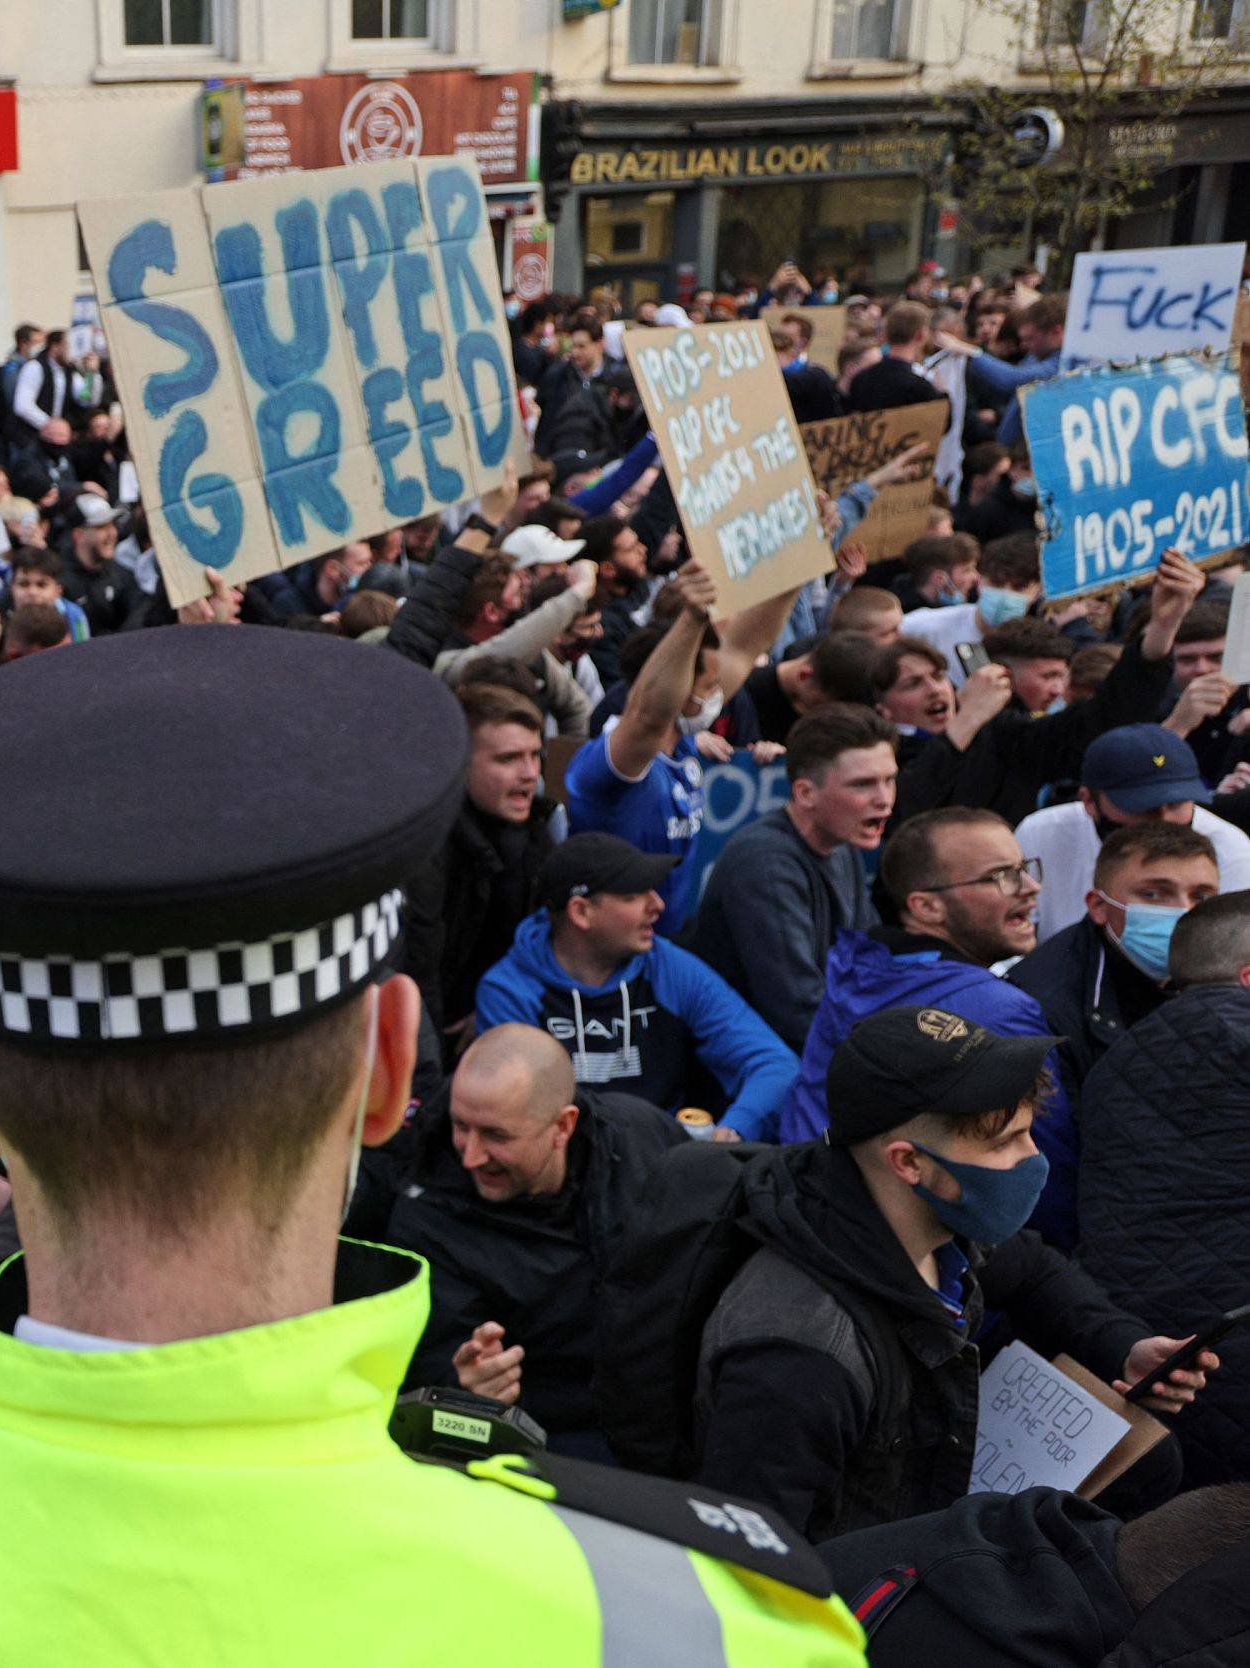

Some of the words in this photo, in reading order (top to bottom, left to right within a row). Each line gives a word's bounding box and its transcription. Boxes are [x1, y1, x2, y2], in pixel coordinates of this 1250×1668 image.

[570, 149, 741, 184] BRAZILIAN
[745, 143, 833, 175] LOOK
[108, 165, 495, 418] SUPER
[638, 330, 765, 413] 1905-2021
[159, 331, 513, 570] GREED
[668, 405, 703, 473] RIP
[703, 392, 741, 444] CFC
[753, 415, 798, 473] THE
[1062, 386, 1142, 493] RIP
[1152, 373, 1248, 468] CFC
[717, 477, 825, 580] MEMORIES!
[1075, 480, 1241, 586] 1905-2021
[437, 1417, 465, 1432] 3220
[469, 1423, 487, 1437] SN
[991, 1388, 1017, 1415] BY
[1014, 1406, 1045, 1437] THE
[1041, 1431, 1077, 1467] POOR
[1002, 1356, 1093, 1439] CREATED
